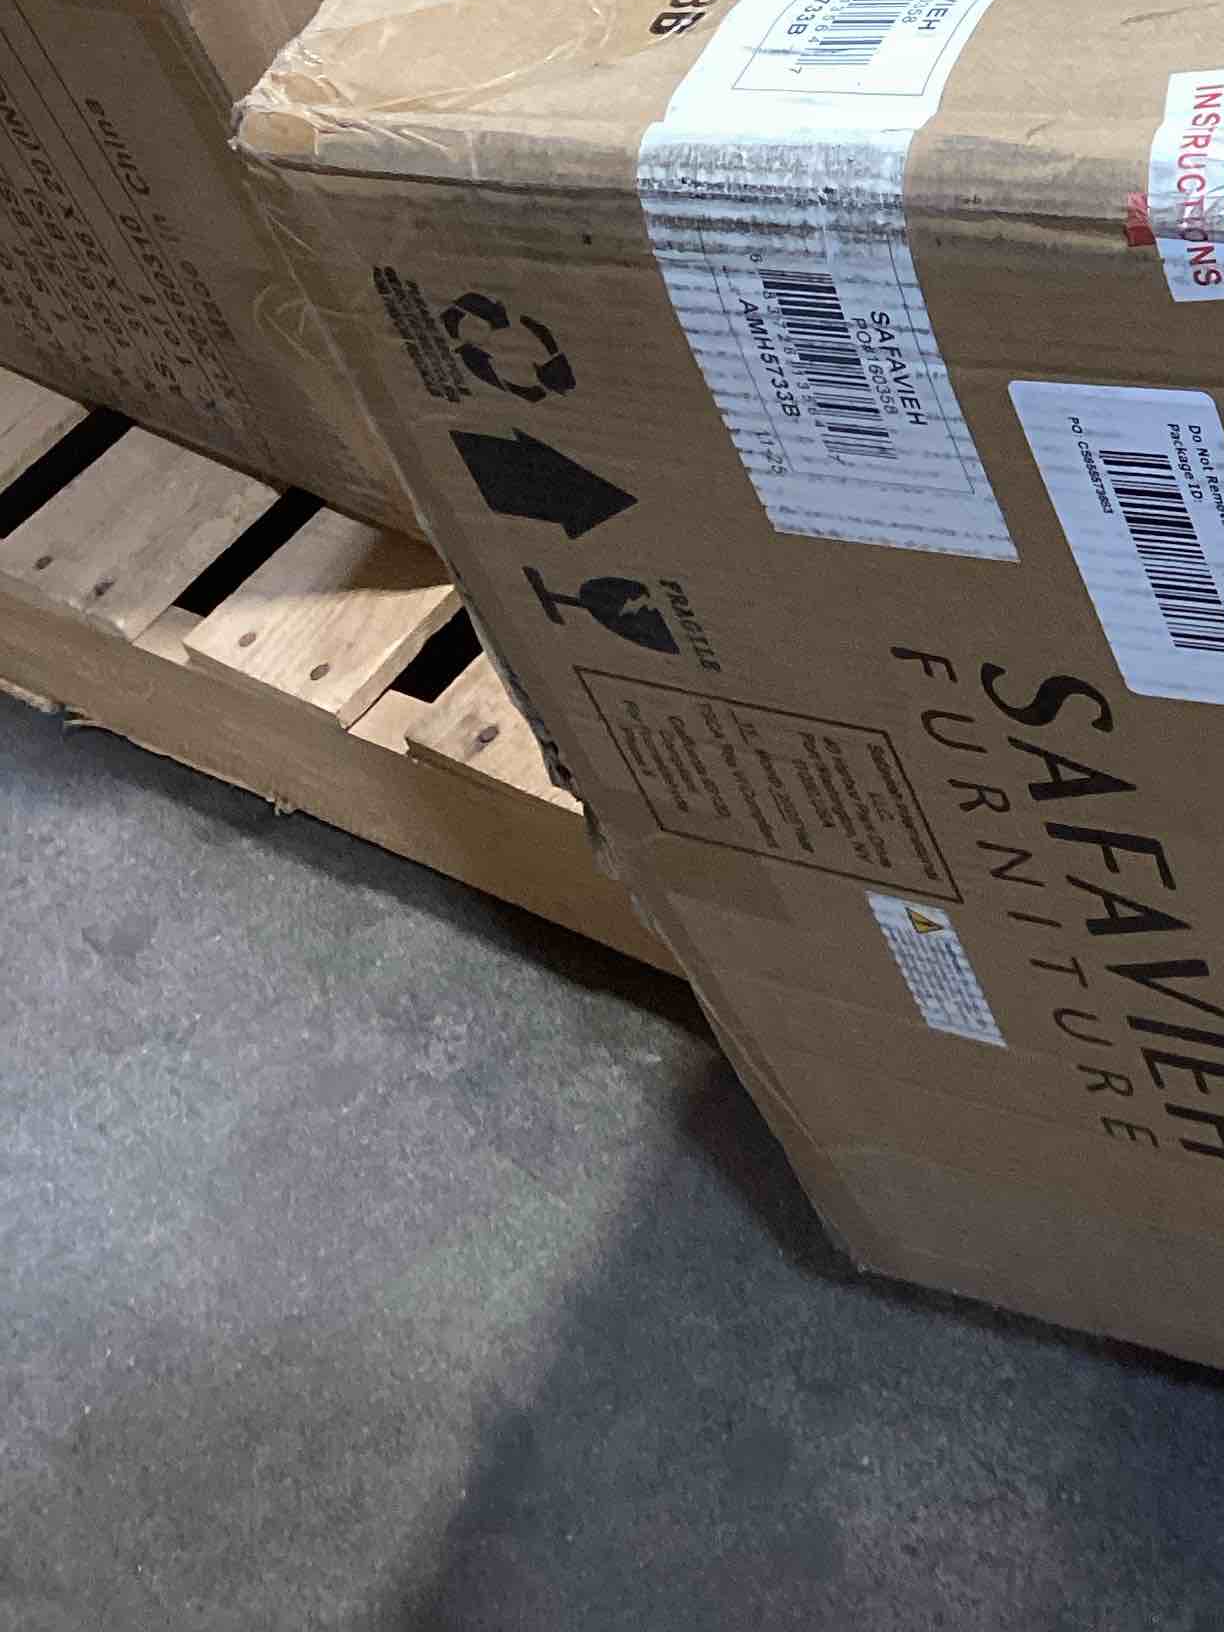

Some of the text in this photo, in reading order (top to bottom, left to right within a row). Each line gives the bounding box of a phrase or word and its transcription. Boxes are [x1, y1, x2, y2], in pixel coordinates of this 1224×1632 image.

[85, 97, 150, 196] China
[738, 297, 801, 419] AMH5733B
[870, 311, 928, 426] SAFAVIEH
[1168, 422, 1195, 481] Package
[1188, 424, 1203, 444] Do
[1197, 448, 1214, 472] Not
[658, 578, 721, 673] FRAGILE
[890, 646, 1160, 1149] FURNITURE
